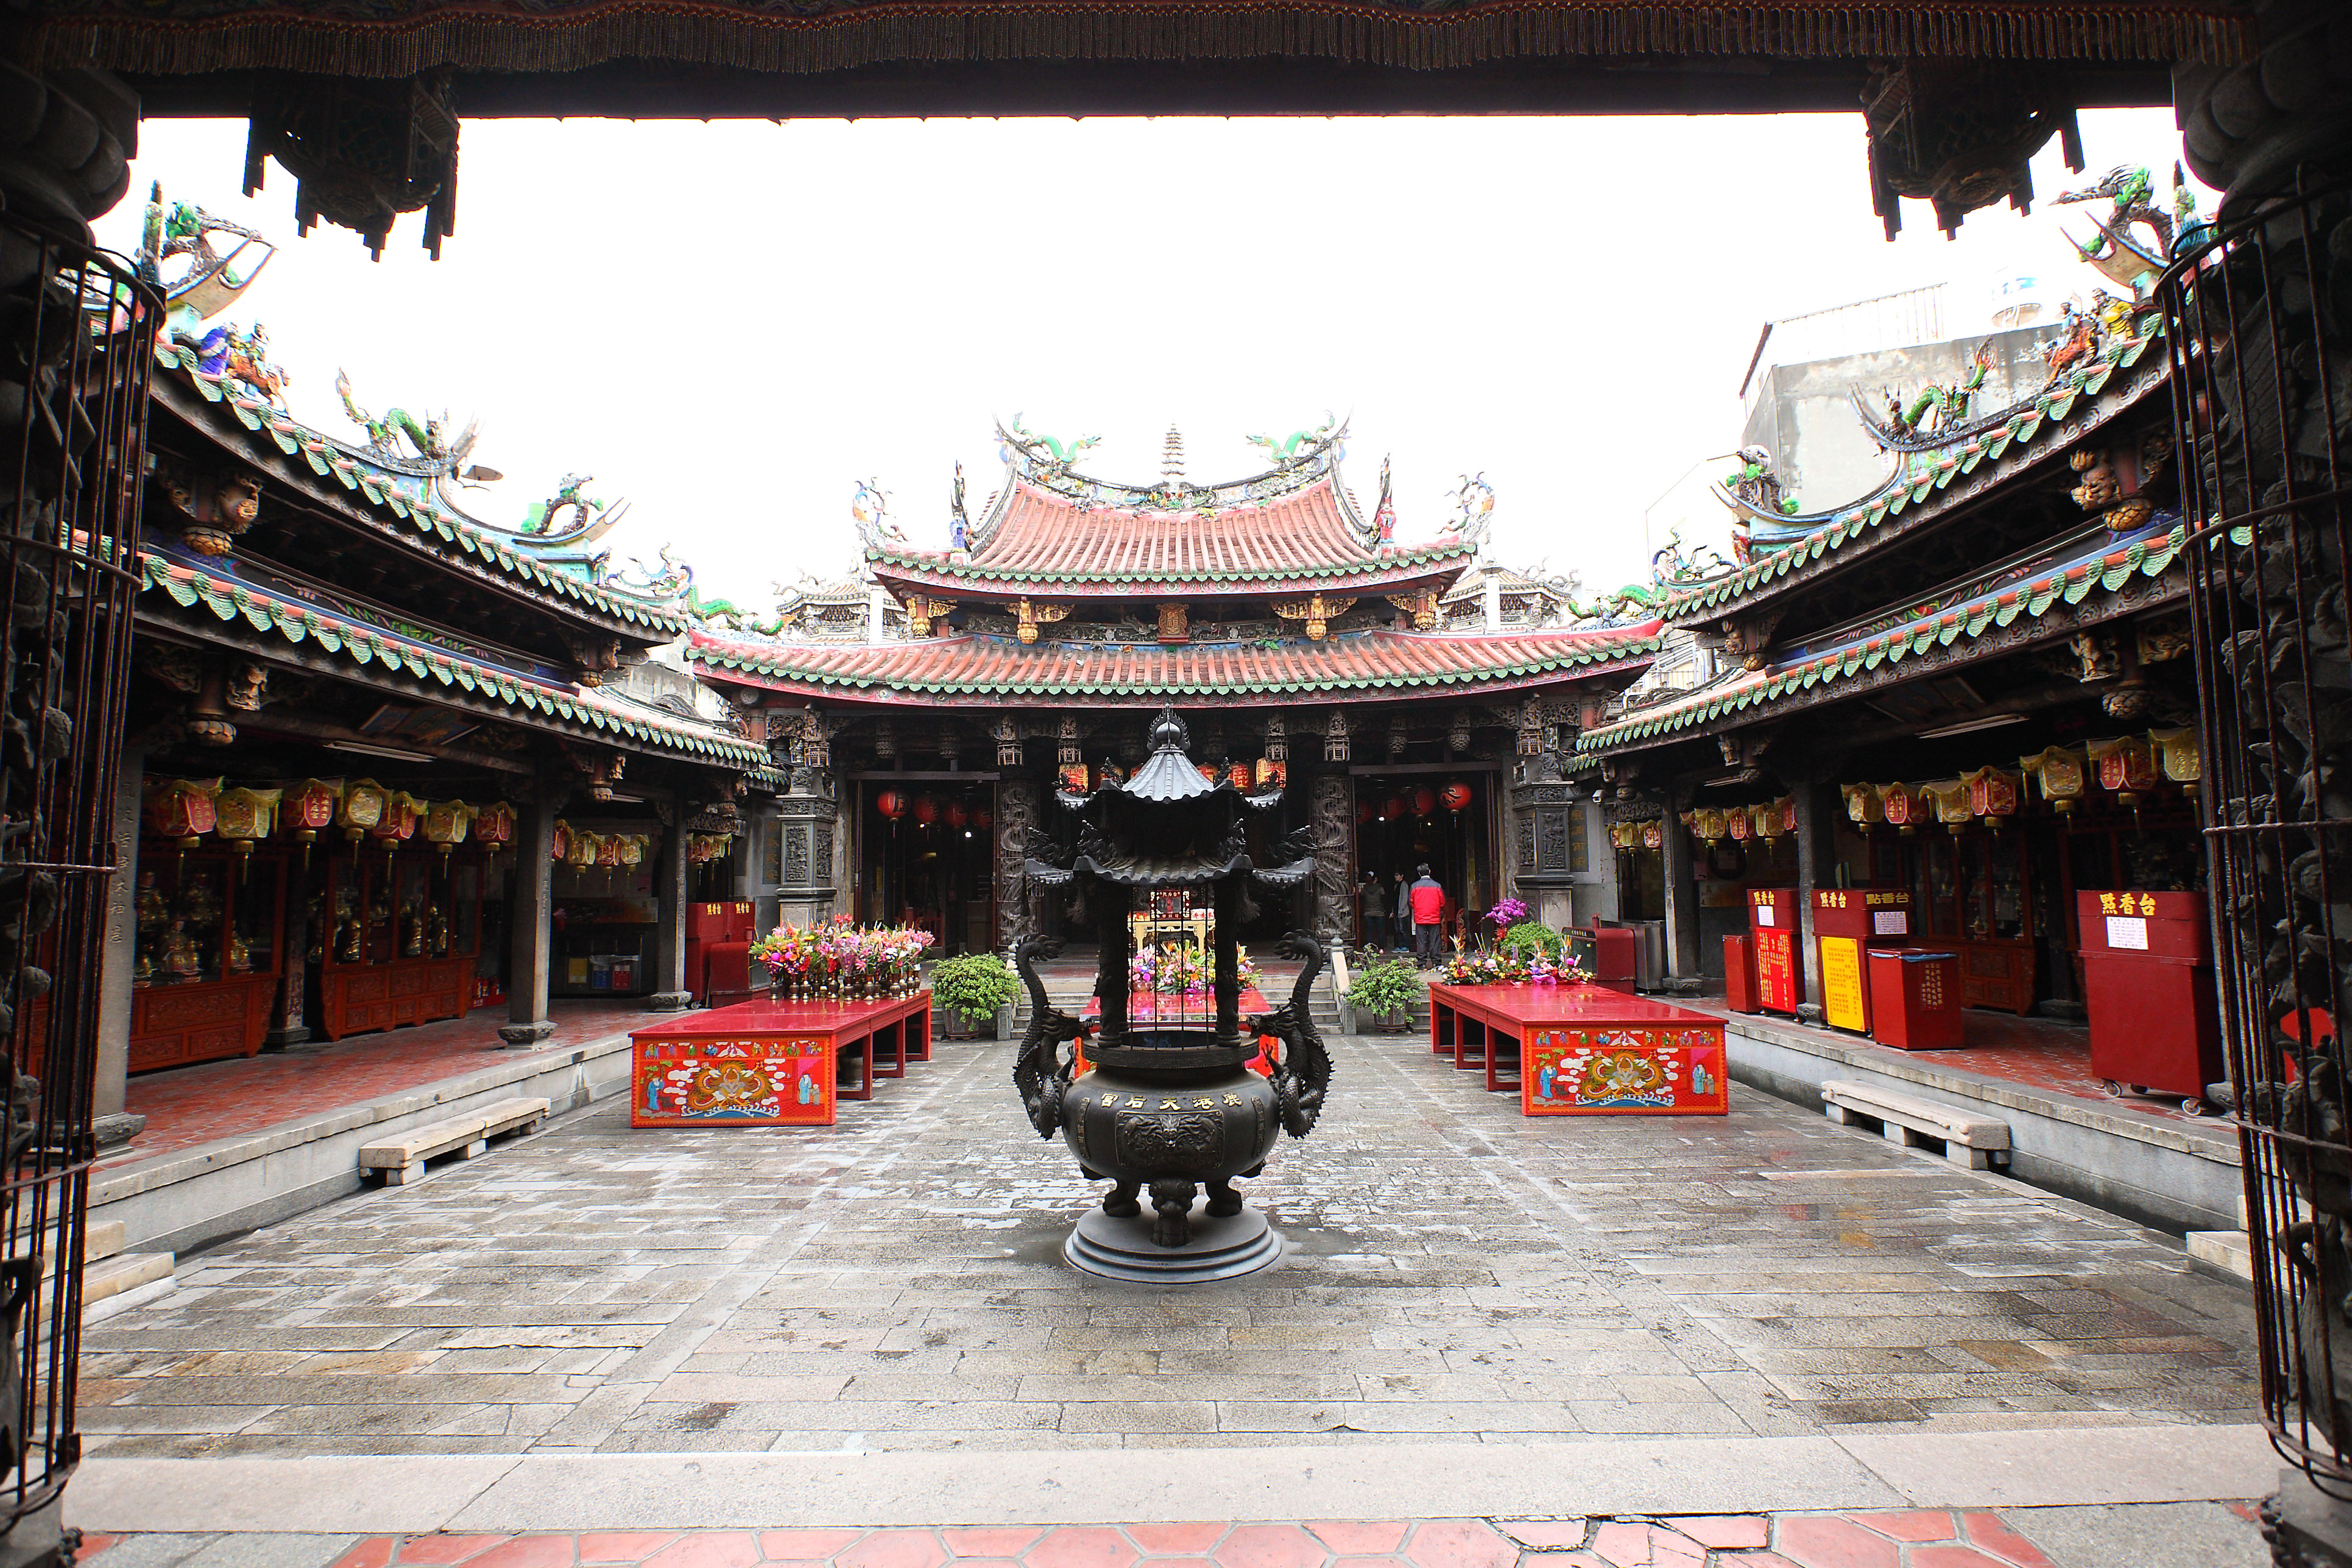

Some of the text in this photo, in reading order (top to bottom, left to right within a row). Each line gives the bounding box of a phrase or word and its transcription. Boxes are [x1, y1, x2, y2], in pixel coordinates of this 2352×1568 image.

[1571, 809, 1586, 867] 風調雨順
[1754, 891, 1774, 905] 點香台
[1820, 892, 1846, 908] 點香台
[1866, 892, 1909, 905] 點香台
[2100, 892, 2156, 916] 點香台
